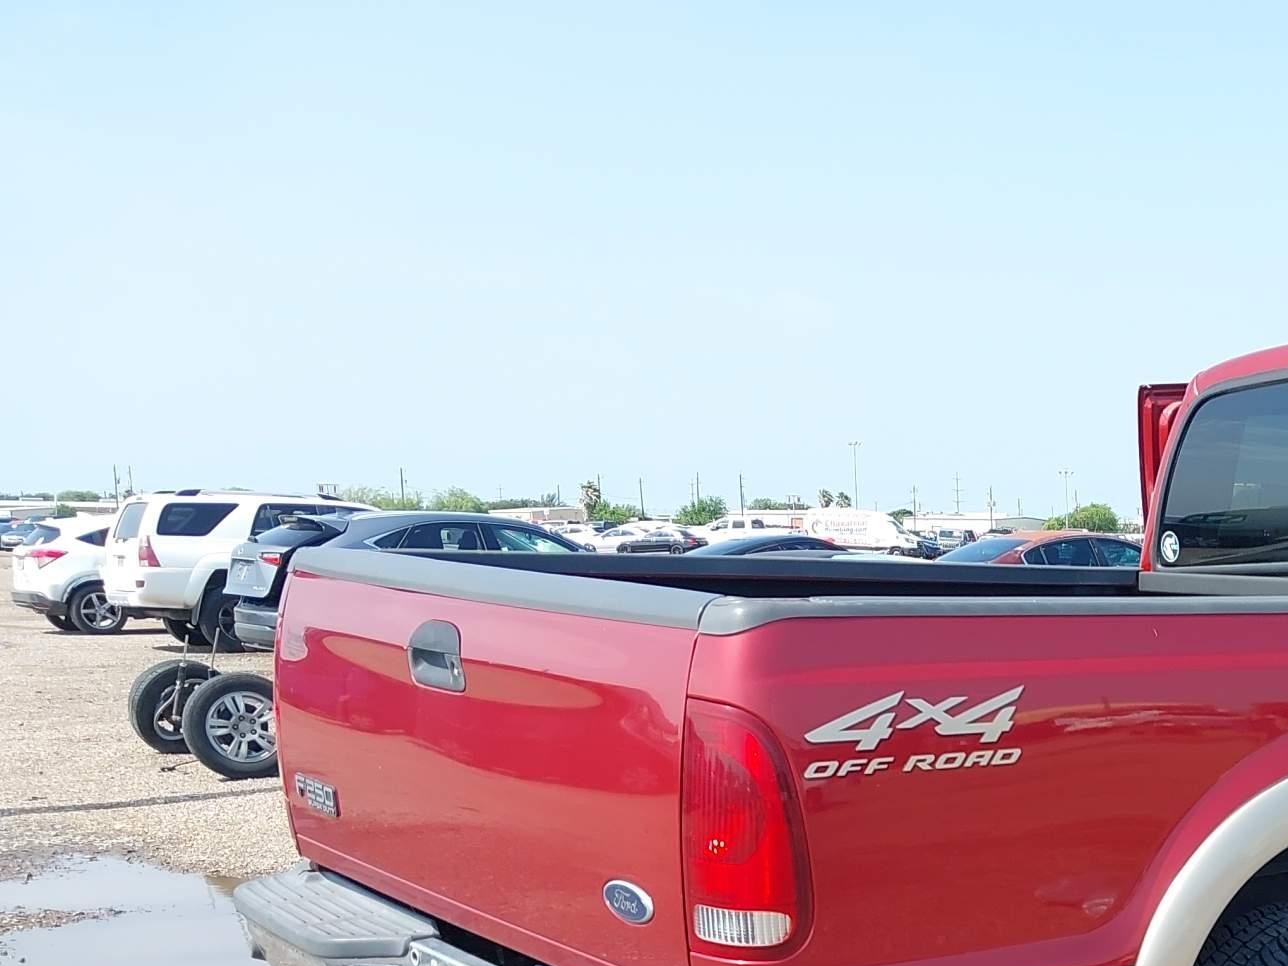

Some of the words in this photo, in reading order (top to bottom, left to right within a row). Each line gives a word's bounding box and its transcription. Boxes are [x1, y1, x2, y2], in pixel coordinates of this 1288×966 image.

[803, 756, 895, 779] OFF
[902, 748, 1023, 772] ROAD
[613, 888, 640, 914] Ford
